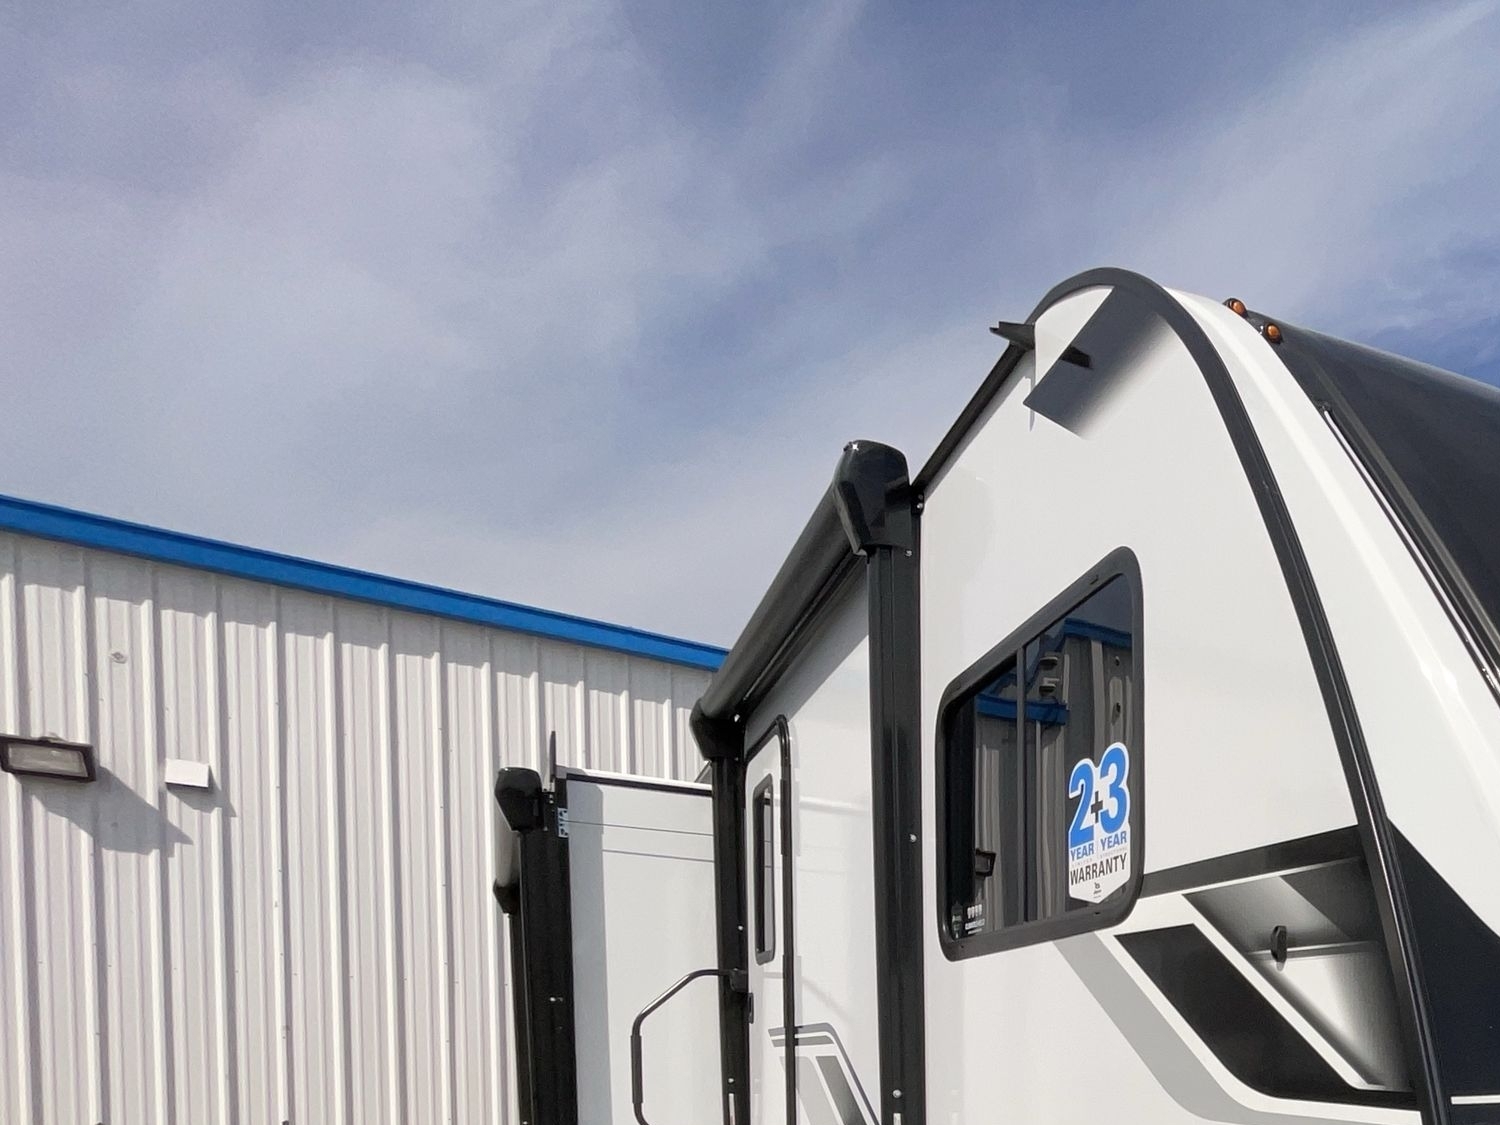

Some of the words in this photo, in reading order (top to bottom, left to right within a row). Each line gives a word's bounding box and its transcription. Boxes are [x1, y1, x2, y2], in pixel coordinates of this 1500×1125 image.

[1070, 843, 1095, 861] YEAR
[1100, 831, 1127, 850] YEAR
[1070, 852, 1127, 886] WARRANTY
